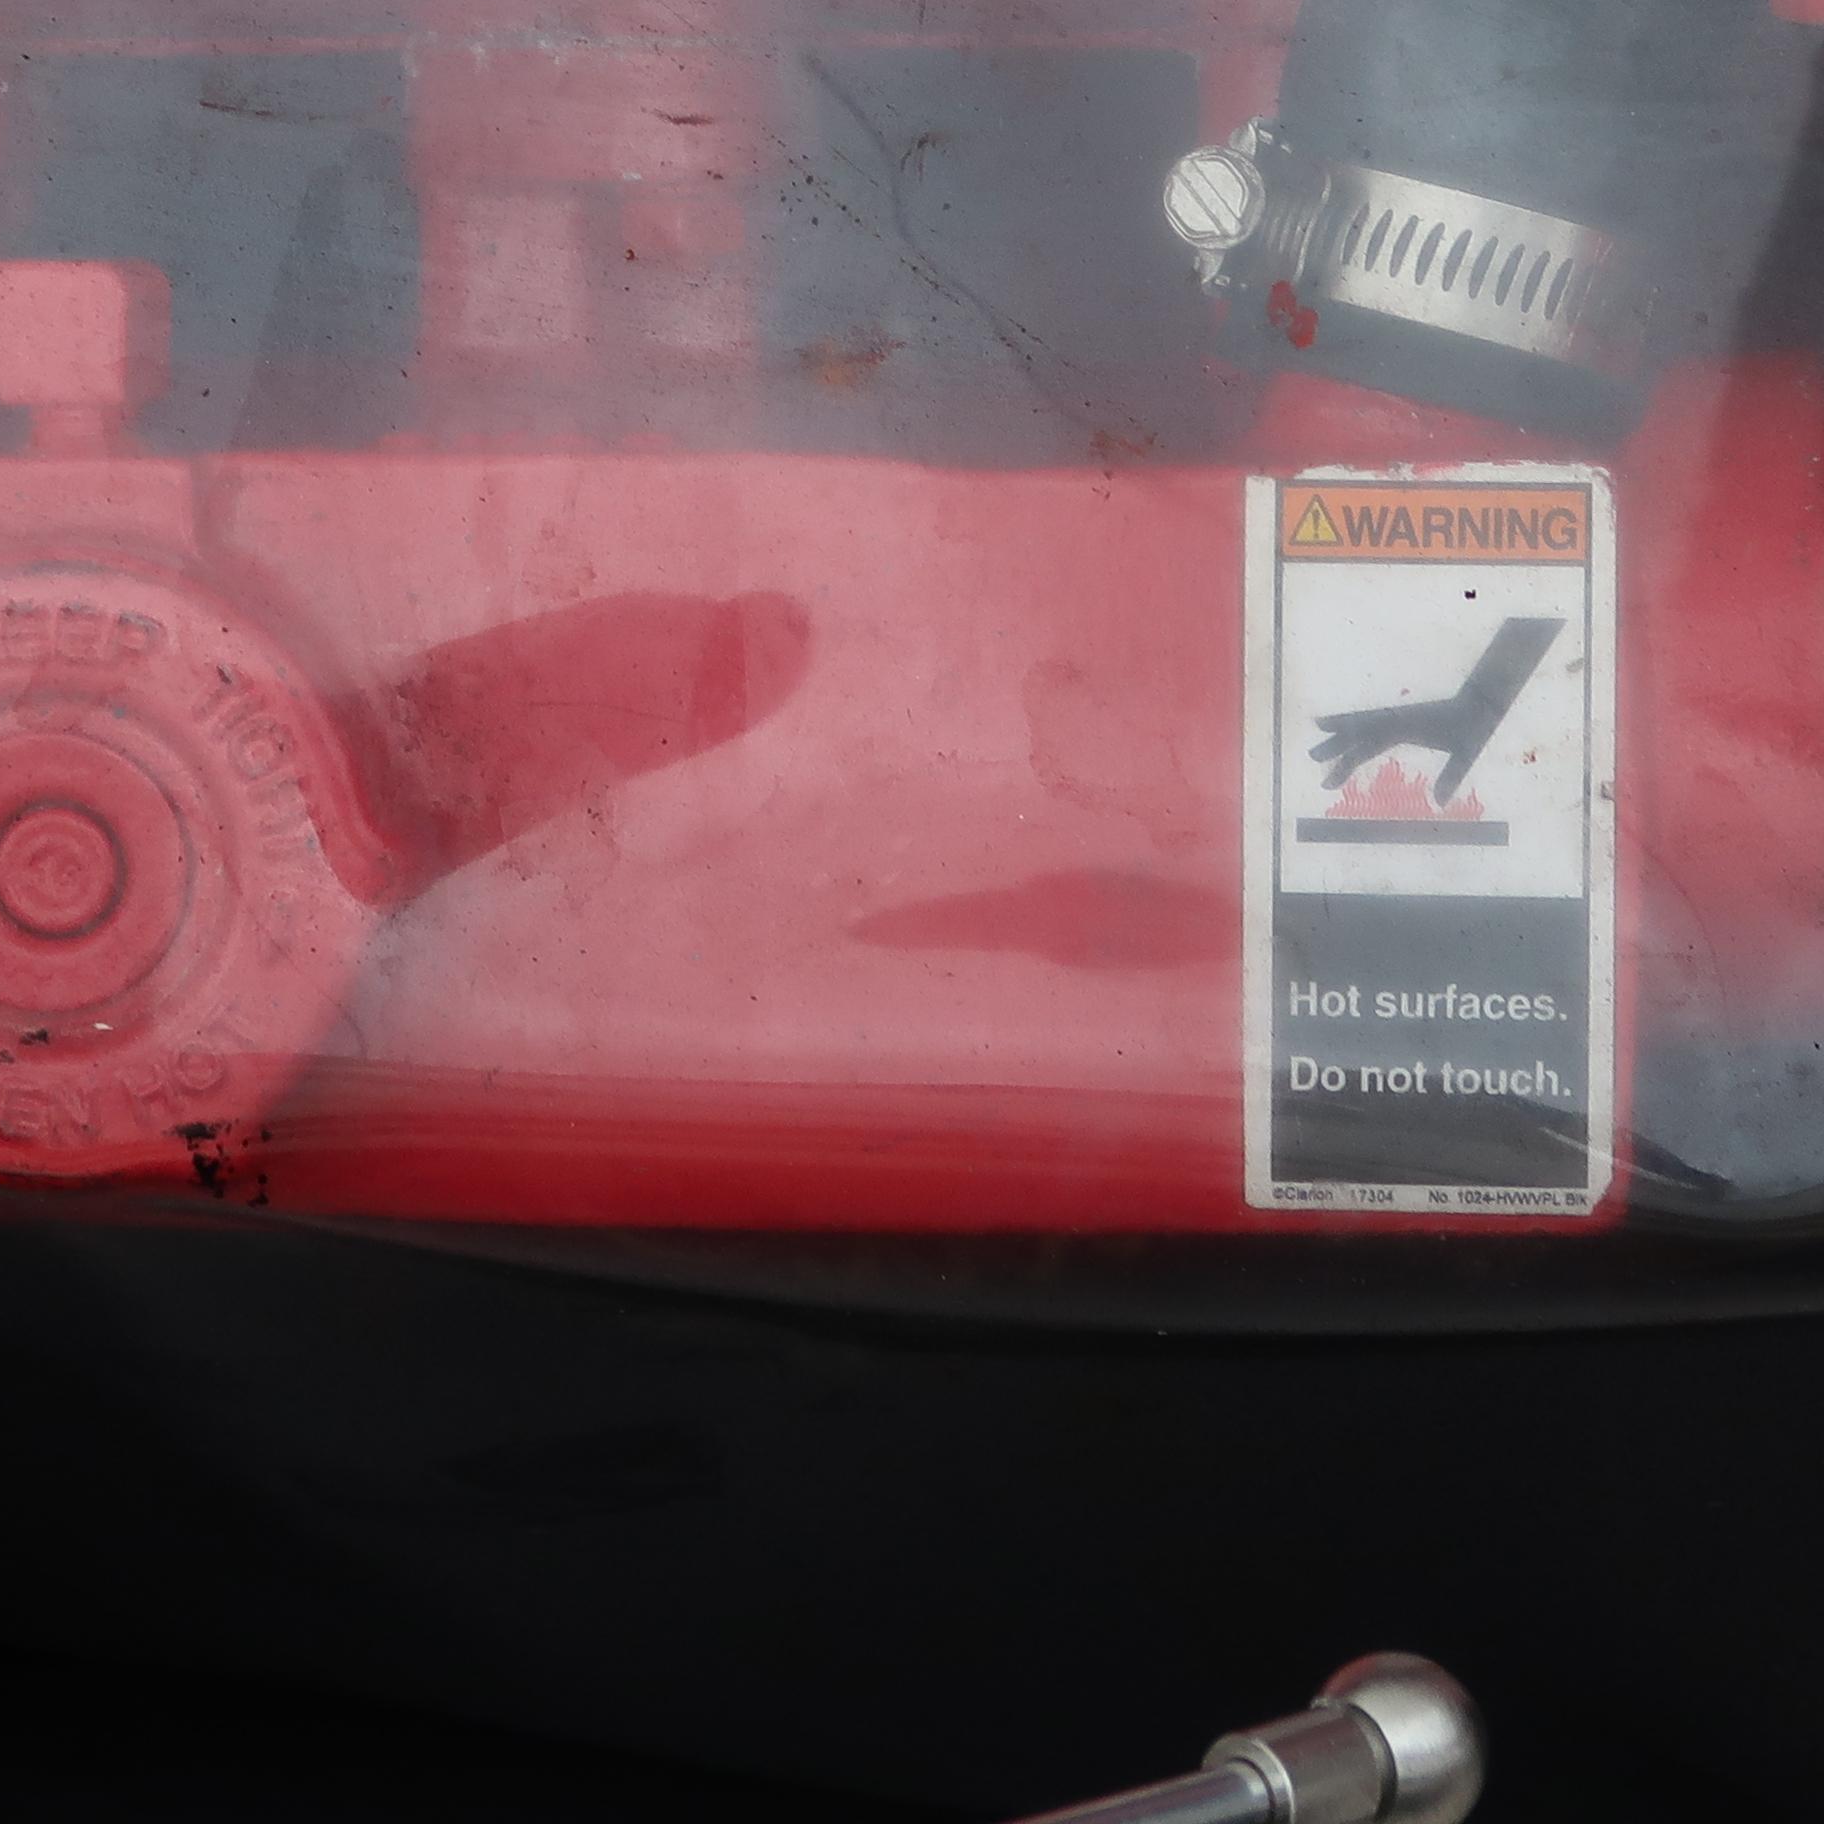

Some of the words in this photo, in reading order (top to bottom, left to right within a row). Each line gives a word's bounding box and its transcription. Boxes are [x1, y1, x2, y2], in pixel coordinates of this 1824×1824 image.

[1344, 506, 1577, 550] WARNING
[189, 664, 311, 862] TIGHT
[1291, 981, 1361, 1017] Hot
[1375, 984, 1566, 1020] surfaces.
[125, 1021, 255, 1121] HOT
[1291, 1056, 1346, 1091] Do
[1361, 1062, 1427, 1093] not
[1441, 1061, 1571, 1096] touch.
